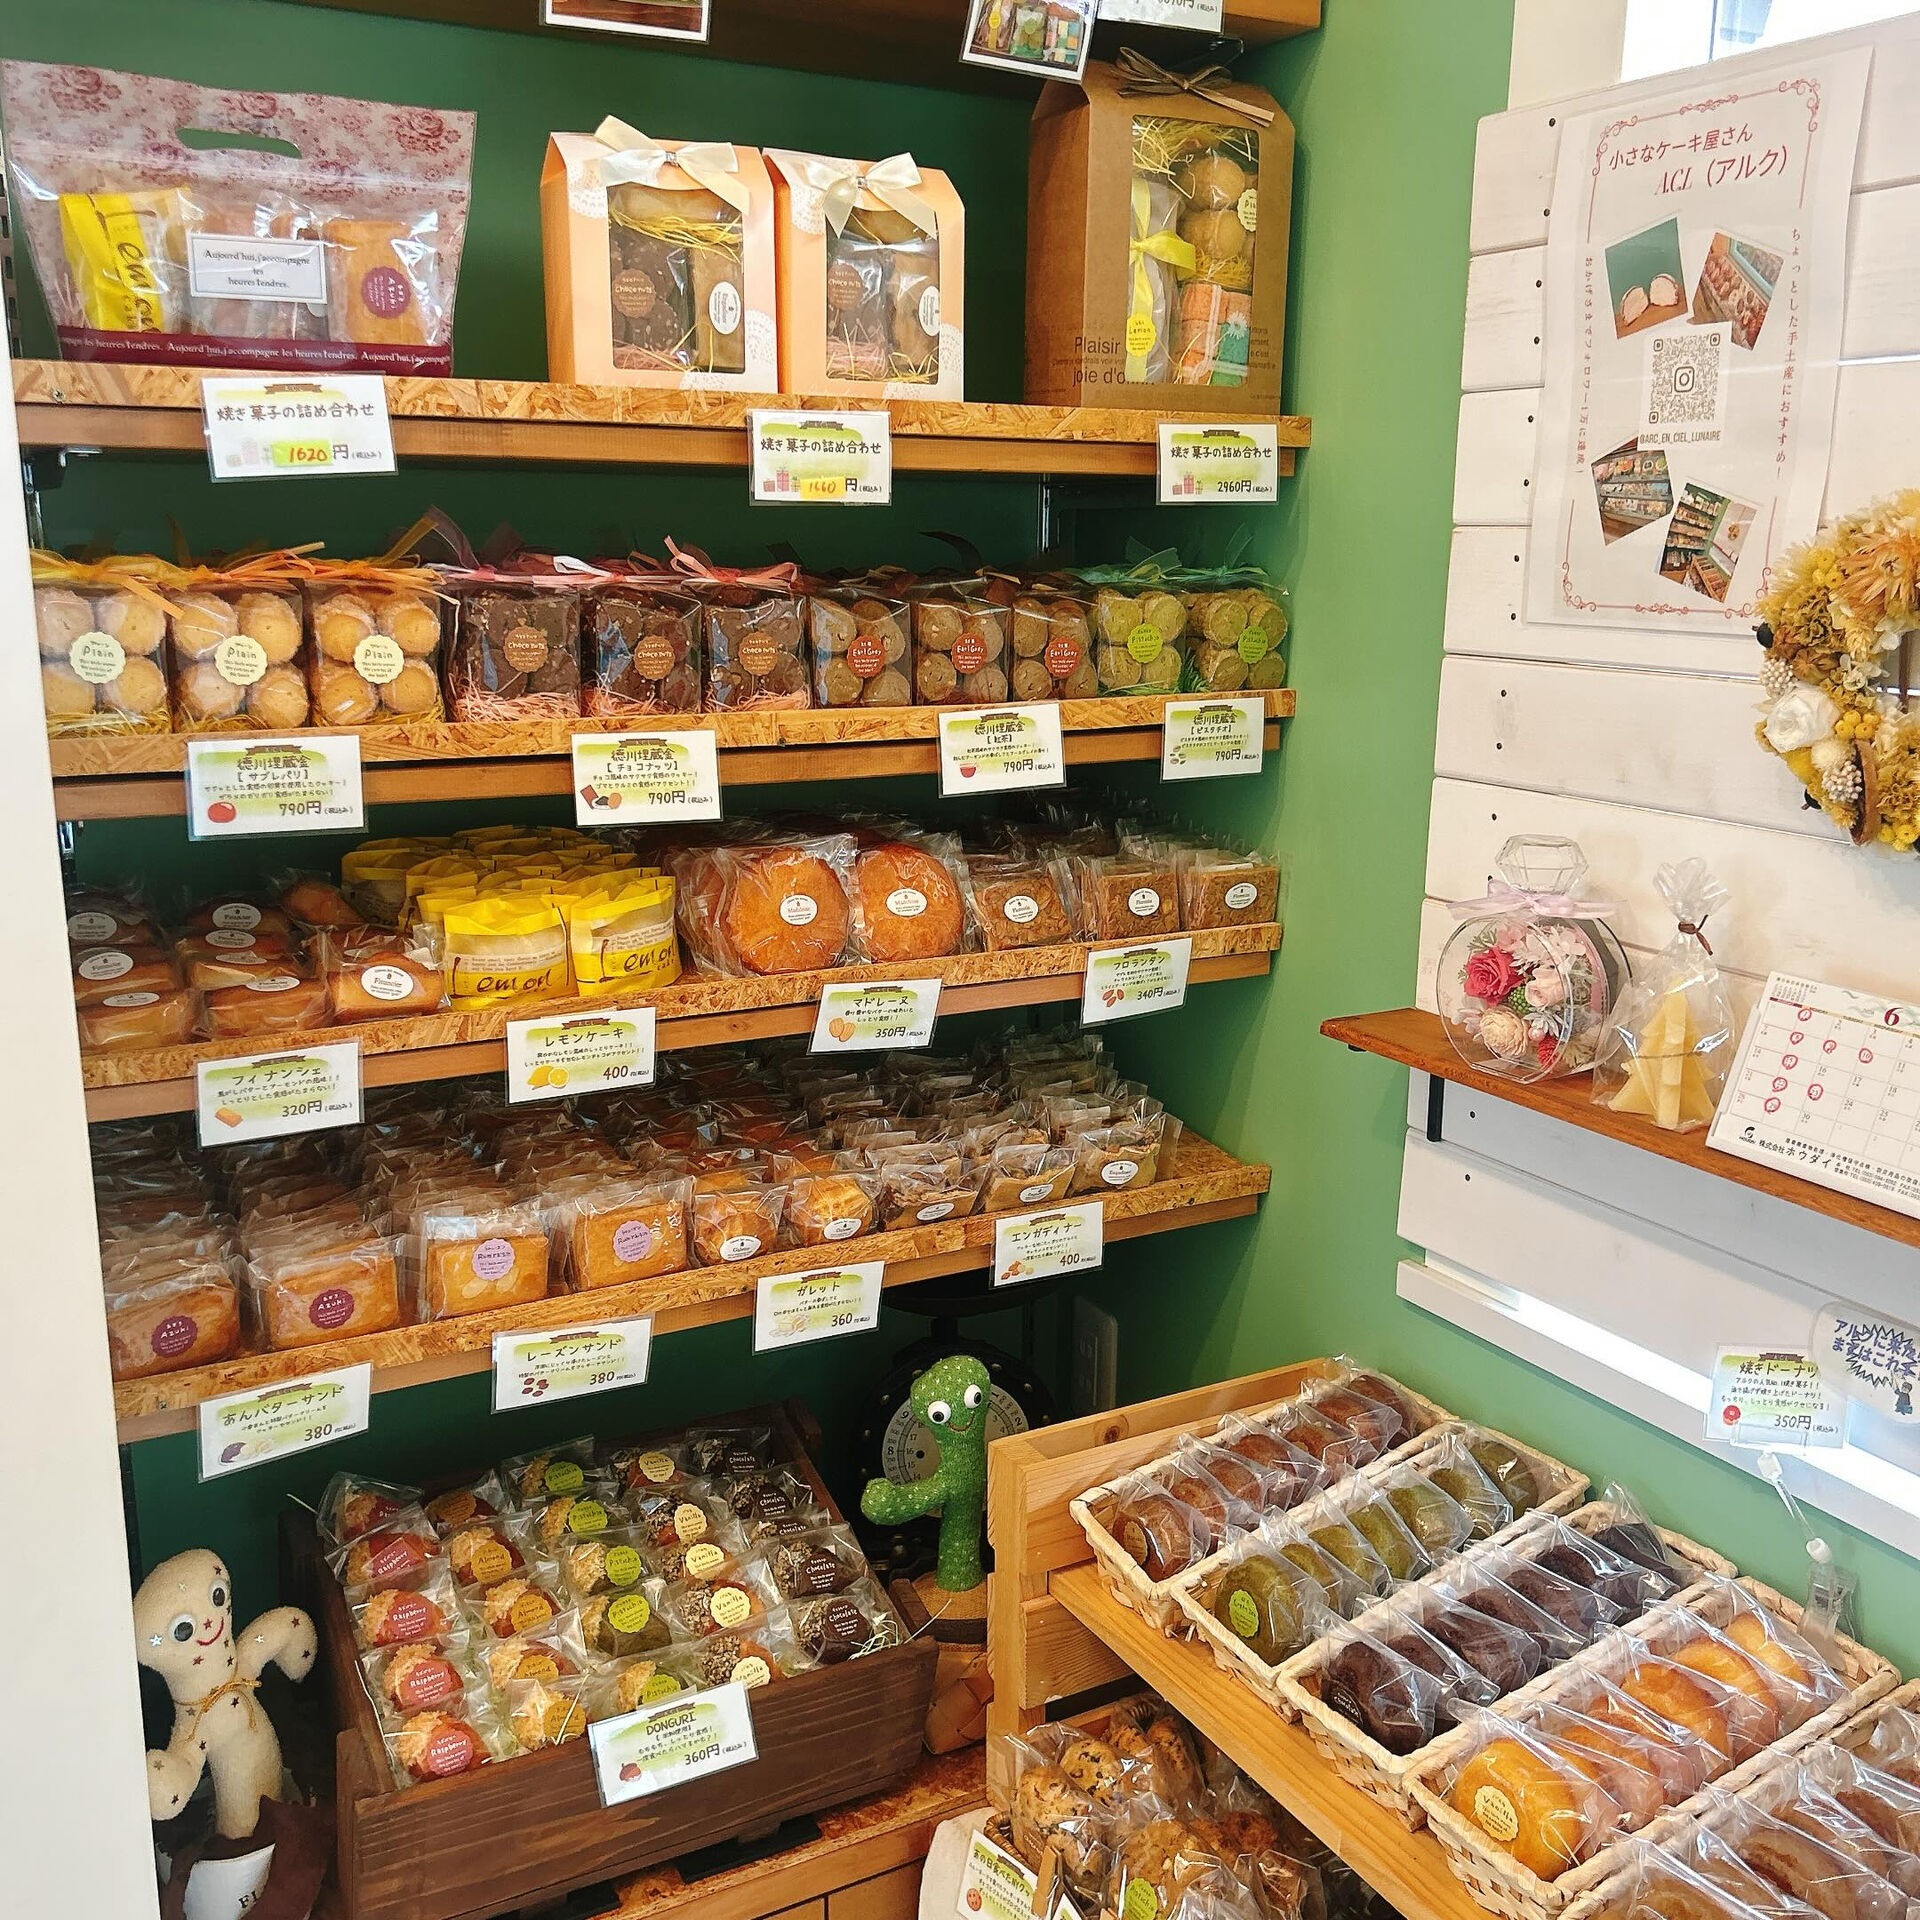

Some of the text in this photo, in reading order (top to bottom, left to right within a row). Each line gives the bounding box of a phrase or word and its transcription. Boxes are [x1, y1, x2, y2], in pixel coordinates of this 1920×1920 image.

[1609, 123, 1753, 170] 小さなケーキ屋さん
[1075, 336, 1121, 354] Plaisir
[1073, 366, 1097, 387] joie
[216, 402, 375, 422] 焼き菓子の詰め合わせ
[1639, 430, 1721, 445] @ARC_EN_CIEL_LUNAIRE
[761, 437, 882, 454] 焼き菓子の詰め合わせ
[1171, 446, 1272, 459] 焼き菓子の詰め合わせ
[83, 646, 114, 658] Plain
[227, 646, 257, 659] Plain
[365, 649, 393, 659] Plain
[1193, 713, 1237, 726] 徳川埋蔵金
[975, 721, 1025, 735] 徳川埋蔵金
[237, 755, 311, 770] 徳川埋蔵金
[611, 748, 676, 762] 徳川埋蔵金
[1215, 749, 1241, 762] 790円
[1003, 759, 1033, 773] 790円
[649, 791, 686, 805] 790円
[279, 801, 321, 816] 790円
[1113, 956, 1166, 971] フロランタン
[1137, 986, 1163, 1001] 340円
[853, 996, 909, 1008] マドレーヌ
[1884, 1007, 1904, 1027] 6
[545, 1027, 624, 1048] レモンケーキ
[875, 1027, 906, 1038] 350円
[233, 1066, 322, 1086] フィナンシェ
[603, 1065, 629, 1081] 400
[282, 1100, 322, 1117] 320円
[1011, 1223, 1082, 1243] エンガディナー
[1060, 1252, 1080, 1267] 400
[797, 1281, 840, 1297] ガレット
[831, 1313, 853, 1328] 360
[527, 1338, 621, 1362] レーズンサンド
[1739, 1360, 1820, 1379] 焼きドーナツ
[589, 1371, 615, 1385] 380
[223, 1386, 345, 1426] あんバターサンド
[1773, 1415, 1812, 1430] 350円
[305, 1424, 333, 1442] 380
[392, 1607, 427, 1621] Raspberry
[410, 1672, 445, 1687] Raspberry
[646, 1711, 697, 1736] DONGURI
[430, 1740, 467, 1757] Raspberry
[684, 1744, 720, 1766] 360円
